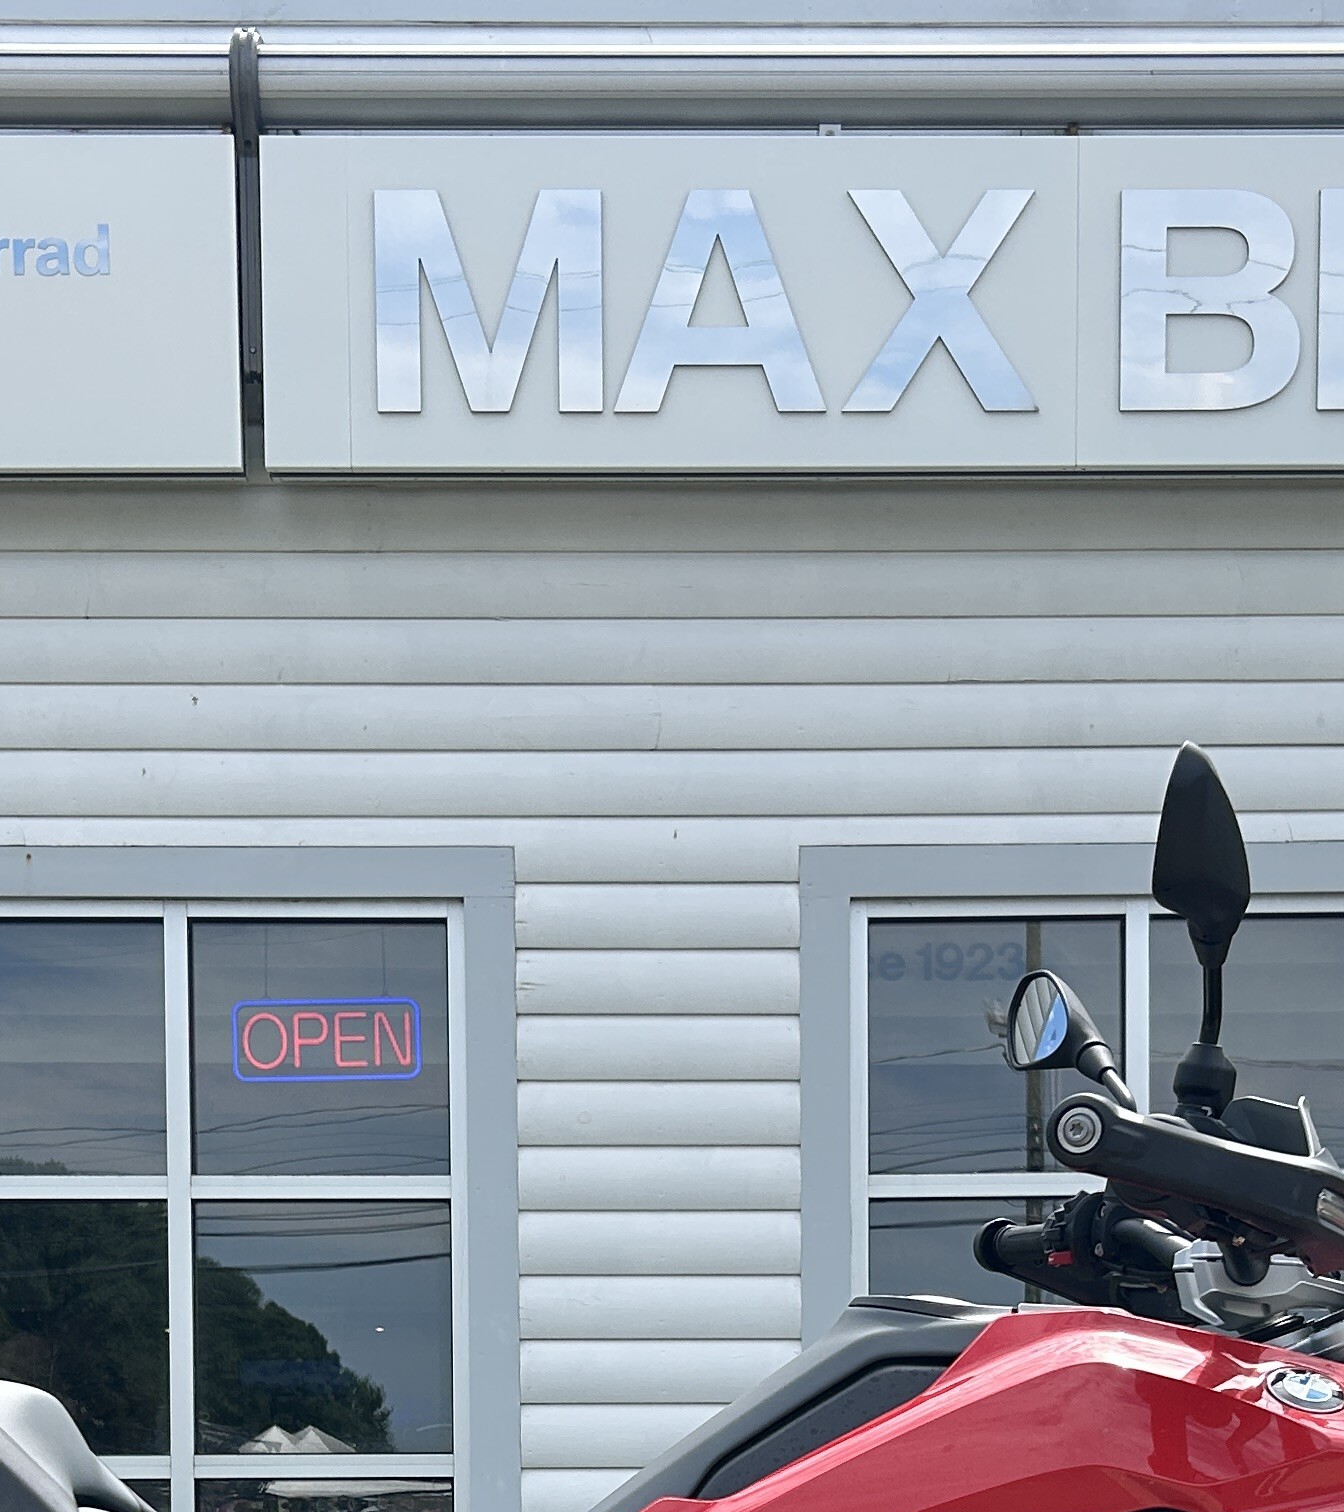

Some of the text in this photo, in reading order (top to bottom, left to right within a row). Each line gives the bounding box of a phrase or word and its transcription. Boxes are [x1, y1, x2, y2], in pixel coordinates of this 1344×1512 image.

[371, 188, 1039, 414] MAX
[915, 941, 1026, 982] 1923
[241, 1010, 412, 1071] OPEN
